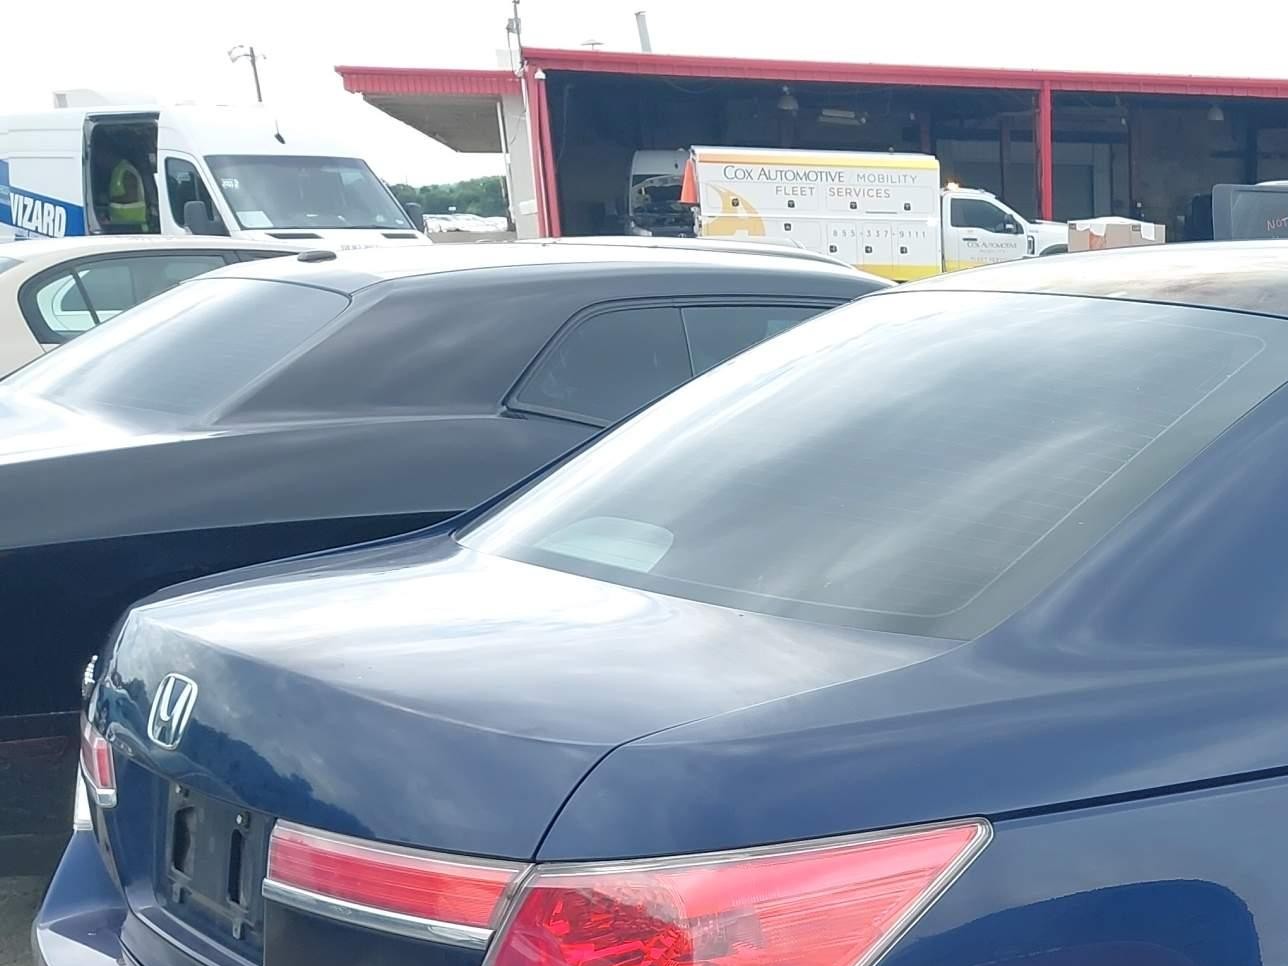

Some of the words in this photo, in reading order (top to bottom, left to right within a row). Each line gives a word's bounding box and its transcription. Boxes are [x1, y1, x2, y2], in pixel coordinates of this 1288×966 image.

[757, 167, 845, 182] AUTOMOTIVE
[856, 173, 918, 184] MOBILITY
[775, 186, 815, 196] FLEET
[828, 187, 891, 198] SERVICES
